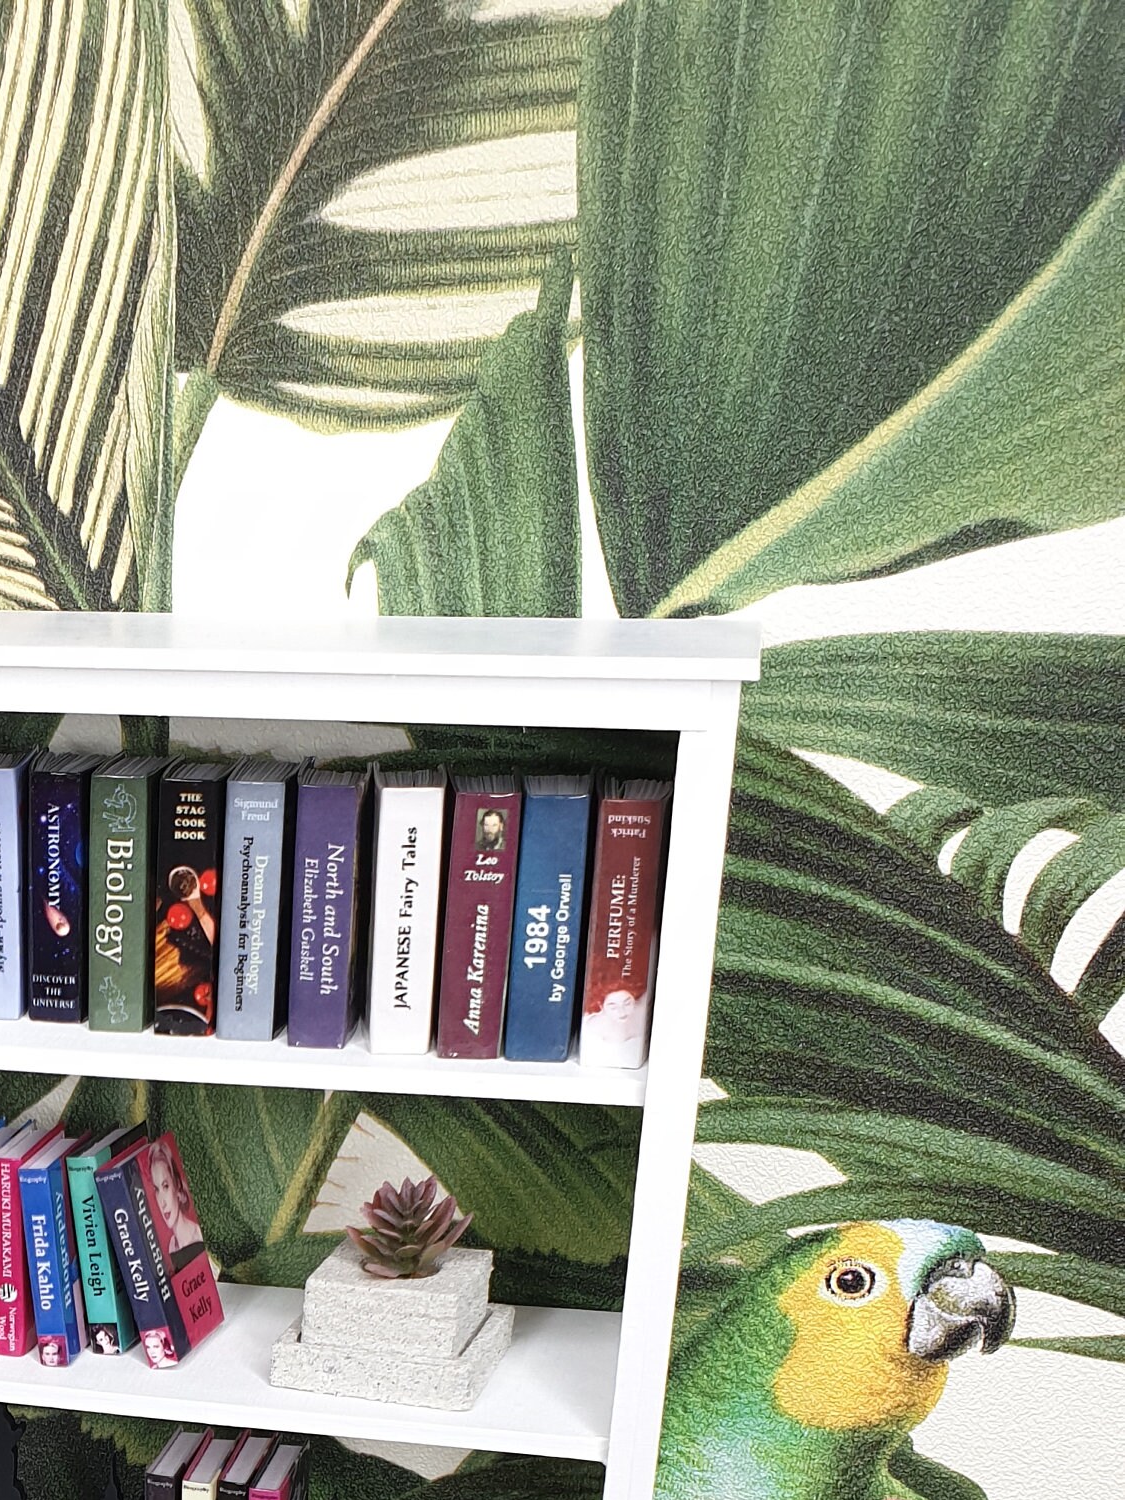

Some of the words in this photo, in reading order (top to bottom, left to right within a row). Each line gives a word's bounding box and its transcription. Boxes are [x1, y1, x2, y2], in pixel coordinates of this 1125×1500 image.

[175, 805, 206, 816] STAG
[179, 793, 203, 803] THE
[233, 797, 279, 810] Sigmund
[241, 810, 271, 822] Freud
[174, 817, 207, 829] COOK
[174, 830, 207, 841] BOOK
[610, 827, 647, 839] Patrick
[47, 802, 61, 909] ASTRONOMY
[326, 843, 345, 900] North
[401, 826, 418, 871] Tales
[475, 854, 499, 867] Leo
[239, 836, 254, 931] Psychoanalysis
[253, 854, 269, 905] Dream
[302, 857, 319, 924] Elizabeth
[399, 877, 419, 918] Fairy
[464, 869, 505, 884] Tolstoy
[555, 873, 573, 921] Orwell
[630, 855, 642, 906] Murderer
[95, 838, 134, 966] Biology
[323, 904, 341, 938] and
[606, 873, 626, 959] PERFUME:
[627, 915, 636, 927] of
[238, 933, 250, 950] for
[246, 908, 266, 995] Psychology:
[298, 927, 316, 982] Gaskell
[466, 903, 489, 983] Karenina
[523, 903, 552, 969] 1984
[550, 925, 570, 981] George
[623, 928, 636, 956] Story
[32, 973, 76, 985] DISCOVER
[44, 986, 61, 996] THE
[234, 953, 249, 1012] Beginners
[319, 943, 339, 996] South
[393, 925, 412, 1010] JAPANESE
[621, 958, 633, 977] The
[32, 998, 75, 1009] UNIVERSE
[462, 984, 483, 1036] Anna
[548, 982, 568, 1003] by
[0, 1163, 11, 1210] HARUKI
[31, 1214, 50, 1258] Frida
[81, 1194, 97, 1248] Vivien
[134, 1186, 171, 1302] Biography
[1, 1212, 13, 1279] MURAKAMI
[55, 1191, 72, 1310] Biography
[113, 1208, 135, 1256] Grace
[128, 1258, 150, 1303] Kelly
[37, 1261, 55, 1311] Kahlo
[87, 1251, 106, 1298] Leigh
[181, 1271, 207, 1299] Grace
[7, 1306, 18, 1352] Norwegian
[188, 1295, 214, 1325] Kelly
